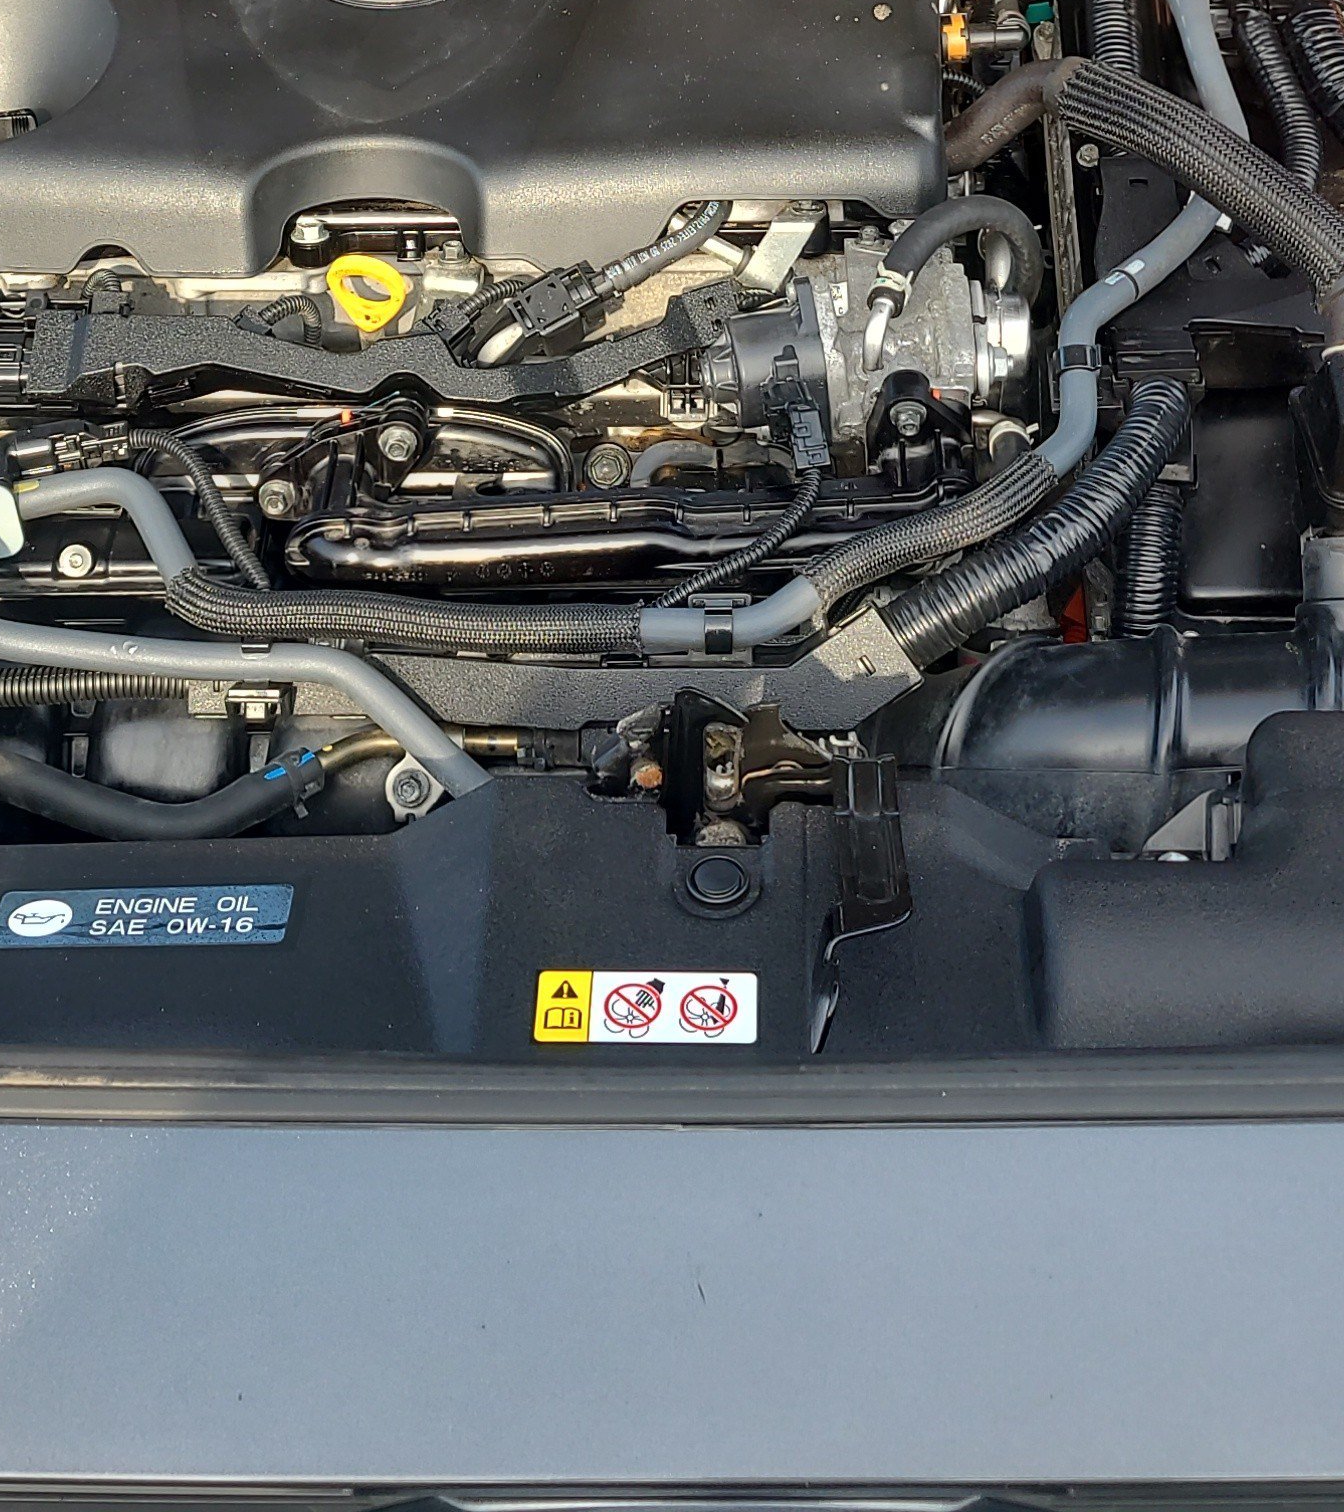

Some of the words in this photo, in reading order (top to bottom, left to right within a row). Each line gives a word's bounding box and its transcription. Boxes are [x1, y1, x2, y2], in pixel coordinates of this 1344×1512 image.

[94, 896, 198, 915] ENGINE
[216, 895, 259, 913] OIL
[89, 918, 145, 936] SAE
[166, 916, 254, 934] 0W-16
